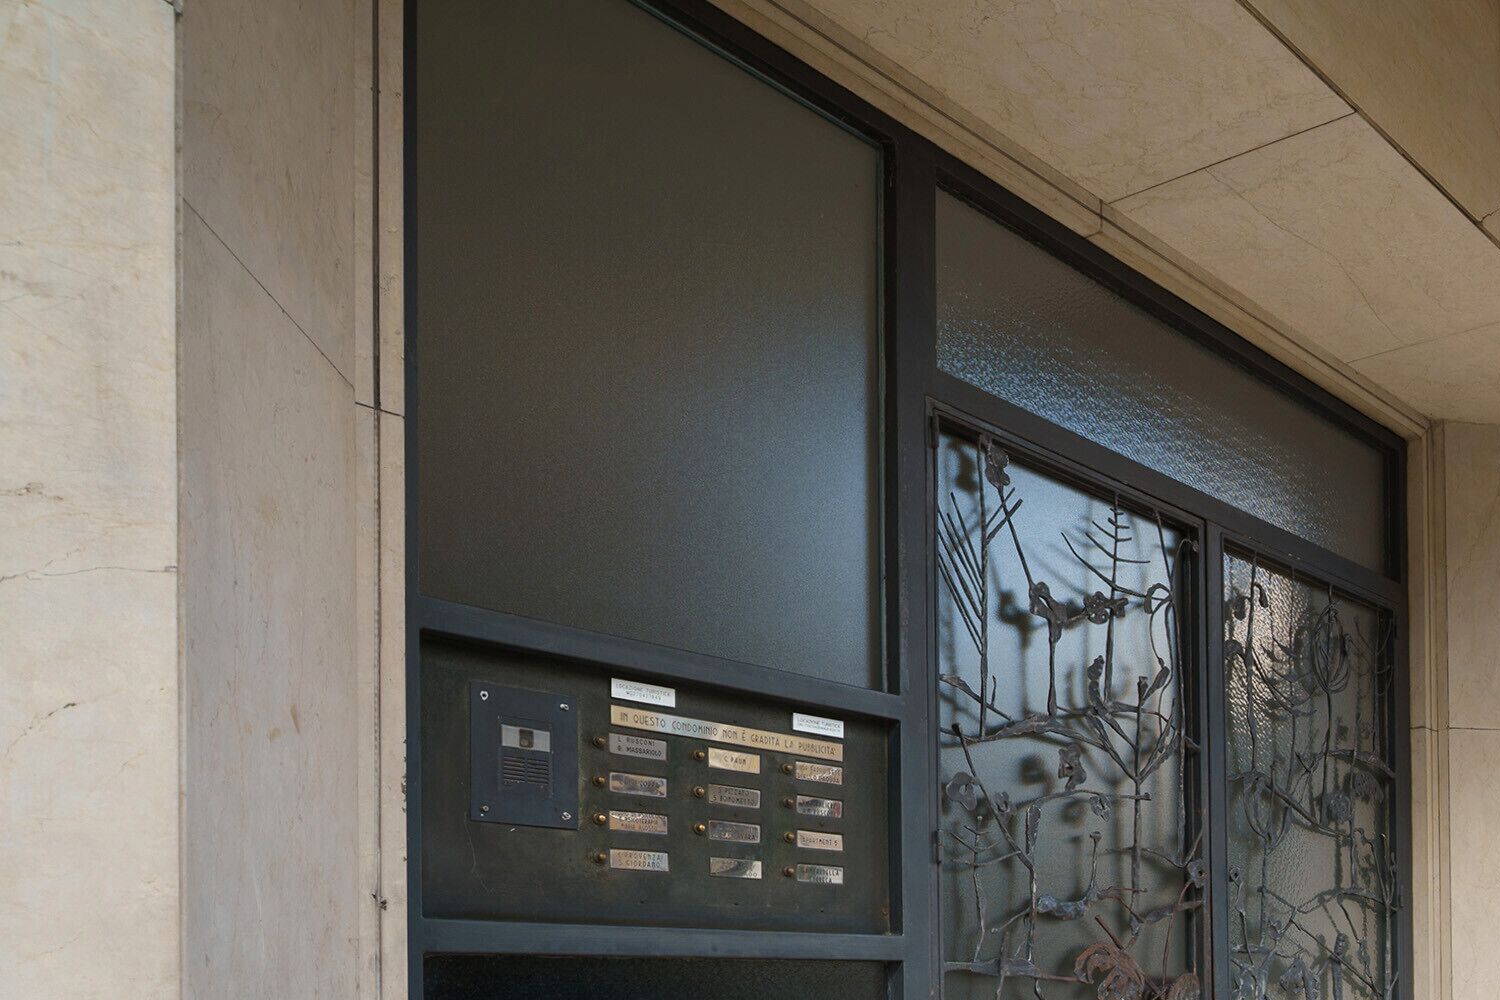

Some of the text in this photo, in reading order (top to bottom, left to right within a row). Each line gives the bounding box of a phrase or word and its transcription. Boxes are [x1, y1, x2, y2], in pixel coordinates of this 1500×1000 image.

[620, 712, 628, 722] IN
[634, 714, 666, 728] QUESTO
[672, 720, 718, 736] CONDOMINIO
[722, 728, 737, 739] NON
[751, 734, 780, 746] GRADITA
[784, 740, 793, 748] LA
